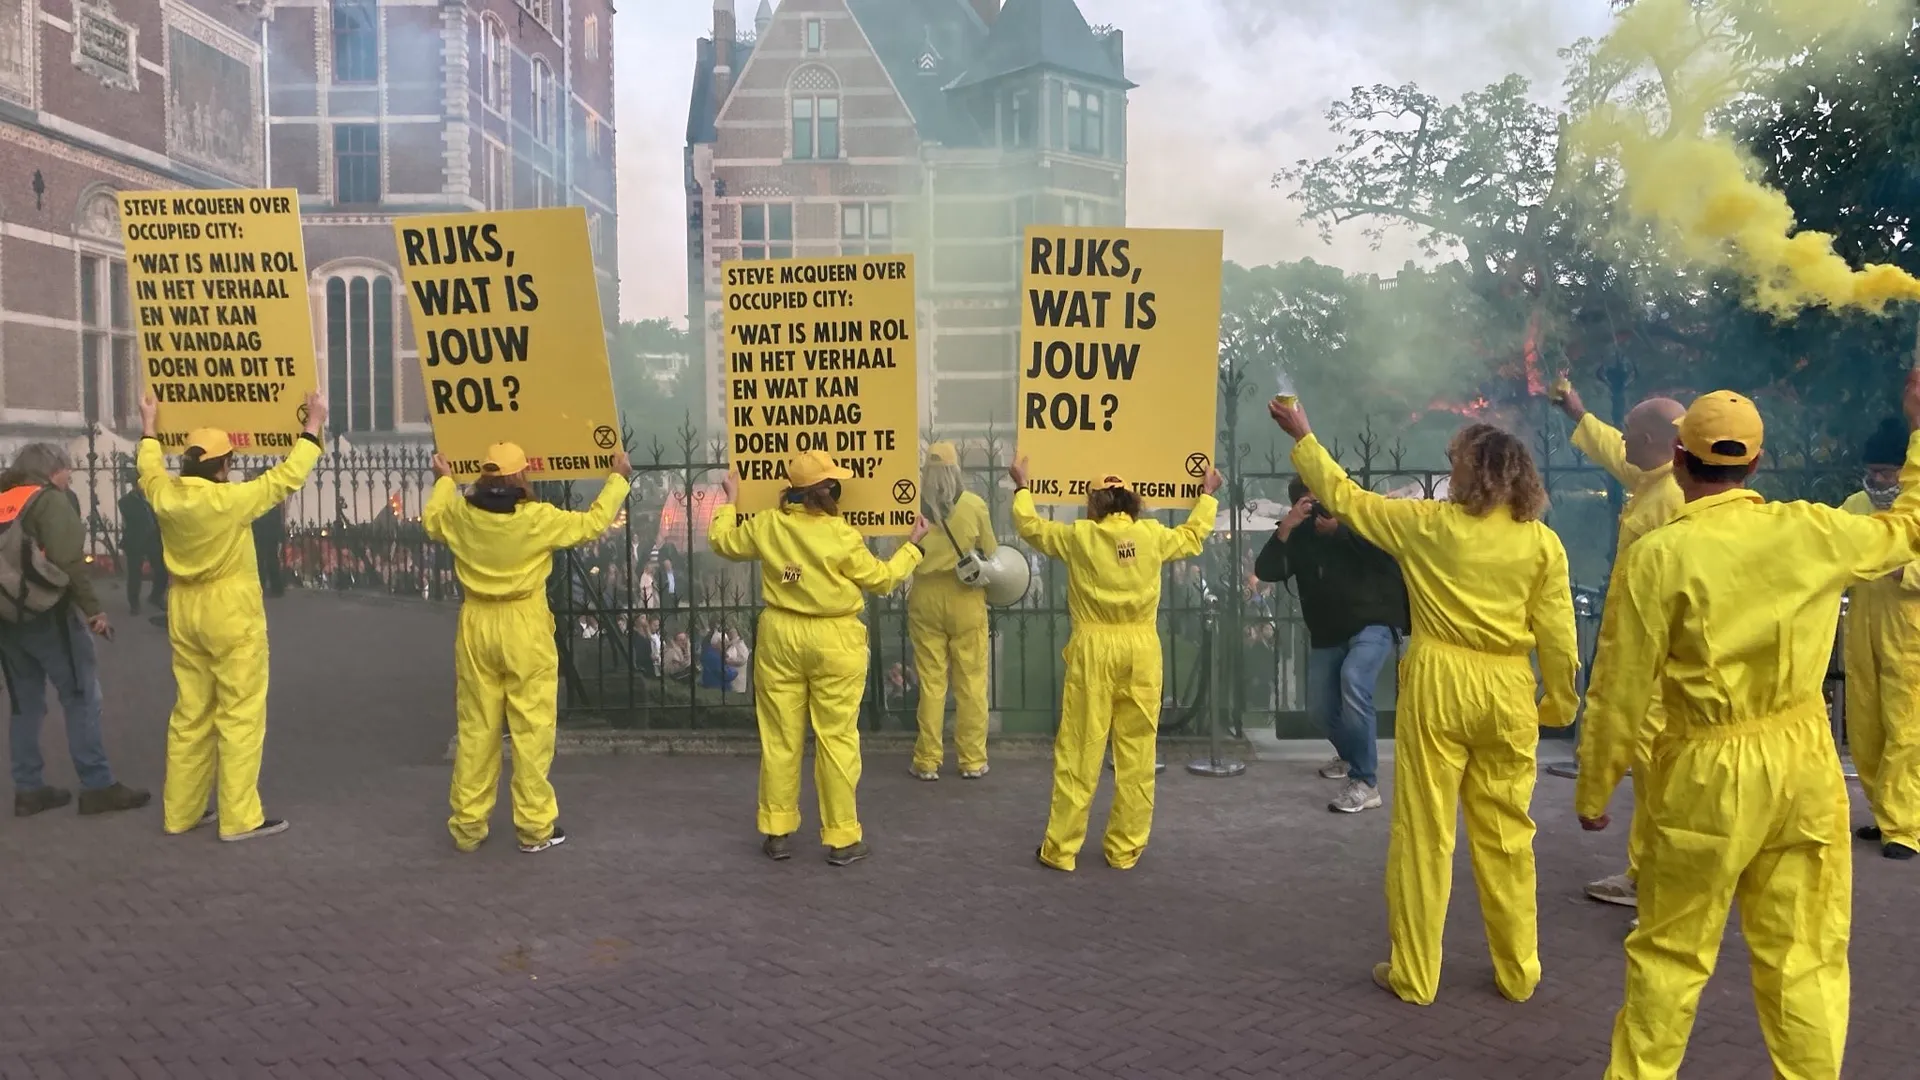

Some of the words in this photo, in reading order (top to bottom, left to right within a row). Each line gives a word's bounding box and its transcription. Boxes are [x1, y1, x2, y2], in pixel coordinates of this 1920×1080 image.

[124, 199, 168, 216] STEVE
[173, 198, 245, 215] MCQUEEN
[250, 197, 291, 214] OVER
[128, 223, 201, 241] OCCUPIED
[206, 222, 243, 239] CITY:
[402, 223, 515, 268] RIJKS,
[186, 252, 203, 273] IS
[209, 252, 256, 273] MIJN
[261, 251, 298, 272] ROL
[1030, 237, 1142, 285] RIJKS,
[728, 267, 775, 286] STEVE
[780, 263, 857, 284] MCQUEEN
[862, 261, 907, 281] OVER
[136, 280, 157, 300] IN
[163, 279, 195, 300] HET
[203, 278, 290, 300] VERHAAL
[411, 276, 491, 317] WAT
[504, 273, 539, 313] IS
[729, 292, 808, 311] OCCUPIED
[813, 290, 853, 309] CITY:
[140, 306, 164, 326] EN
[169, 306, 210, 326] WAT
[216, 305, 257, 326] KAN
[1029, 289, 1112, 328] WAT
[1124, 291, 1157, 330] IS
[144, 332, 164, 352] IK
[169, 331, 262, 352] VANDAAG
[789, 322, 807, 344] IS
[813, 320, 863, 344] MIJN
[870, 319, 909, 341] ROL
[426, 325, 530, 368] JOUW
[148, 357, 199, 377] DOEN
[205, 357, 235, 377] OM
[241, 357, 269, 377] DIT
[275, 357, 296, 376] TE
[731, 352, 753, 373] IN
[761, 350, 796, 372] HET
[804, 347, 897, 371] VERHAAL
[1026, 340, 1141, 381] JOUW
[431, 375, 521, 415] ROL?
[732, 378, 758, 400] EN
[764, 377, 809, 400] WAT
[816, 375, 859, 399] KAN
[733, 406, 754, 428] IK
[761, 402, 862, 427] VANDAAG
[1025, 392, 1119, 432] ROL?
[158, 432, 189, 446] RIJK
[253, 432, 293, 447] TEGEN
[734, 431, 789, 454] DOEN
[796, 430, 829, 452] OM
[836, 430, 867, 452] DIT
[873, 429, 895, 451] TE
[527, 458, 544, 471] EE
[547, 455, 591, 471] TEGEN
[1028, 479, 1063, 497] IJKS,
[1131, 482, 1176, 498] TEGEN
[842, 511, 885, 526] TEGEN
[890, 510, 916, 526] ING
[1118, 547, 1136, 559] NAT
[783, 571, 801, 581] NAT
